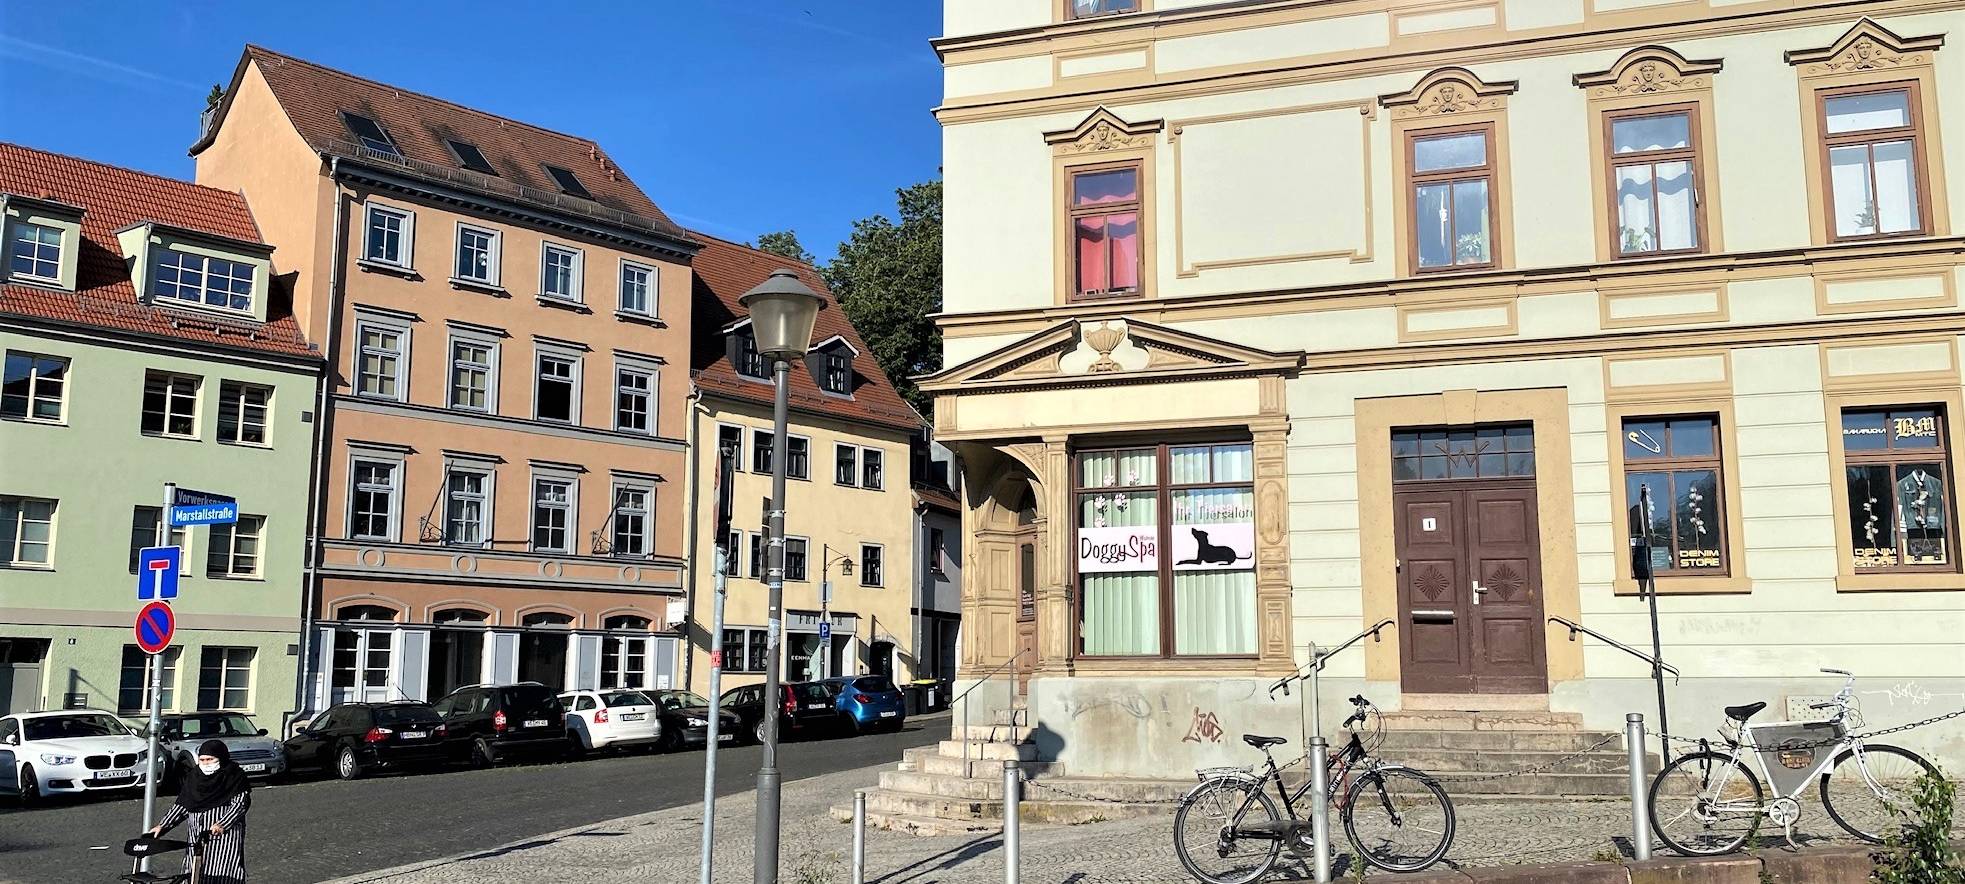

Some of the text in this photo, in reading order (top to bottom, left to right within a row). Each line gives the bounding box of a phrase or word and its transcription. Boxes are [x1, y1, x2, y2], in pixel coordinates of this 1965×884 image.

[175, 507, 233, 522] Marstallstraße
[1679, 549, 1720, 558] DENIM
[1855, 547, 1898, 557] DENIM
[1680, 558, 1720, 568] STORE
